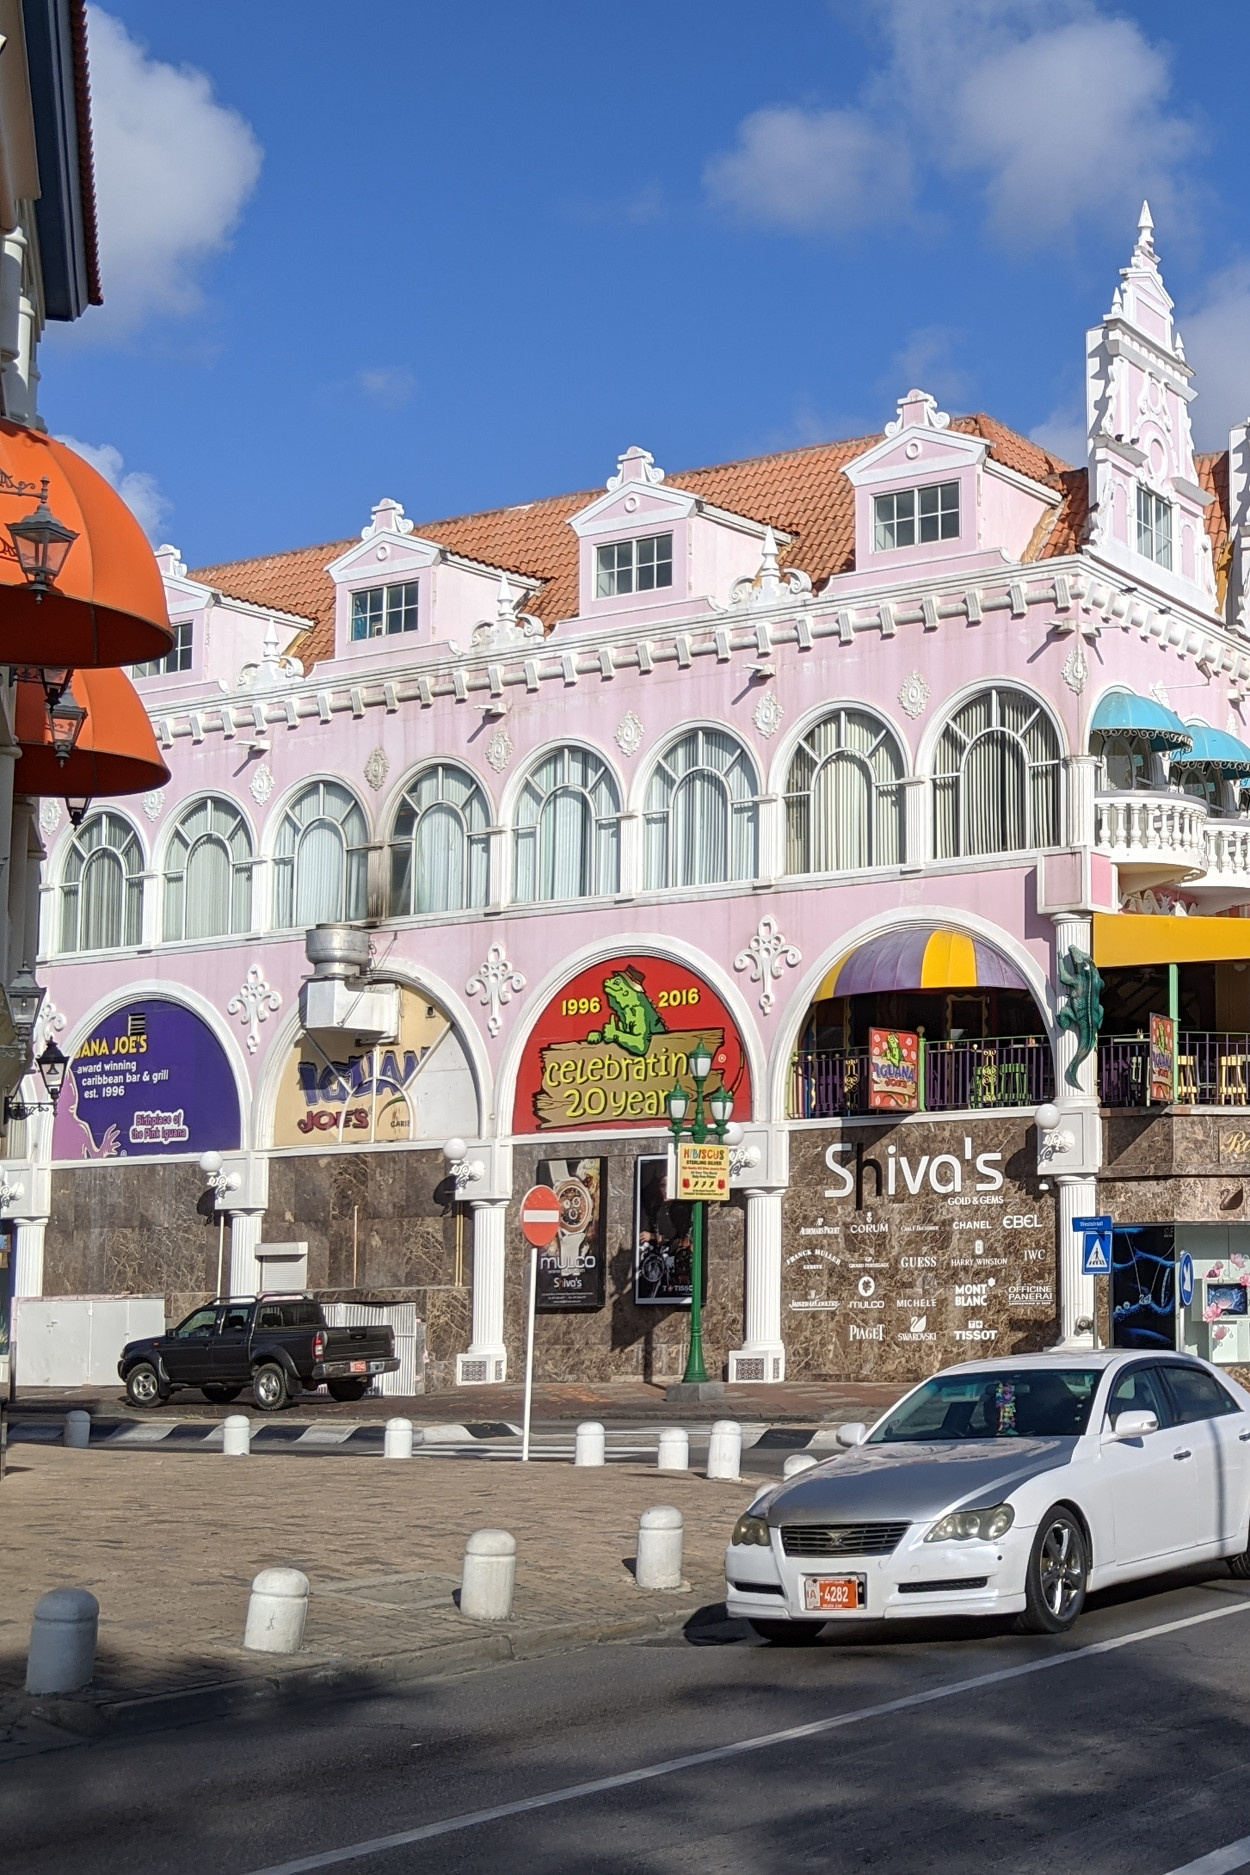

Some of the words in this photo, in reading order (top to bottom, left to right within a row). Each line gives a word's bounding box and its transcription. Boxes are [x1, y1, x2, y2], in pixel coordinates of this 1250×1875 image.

[561, 996, 602, 1016] 1996
[658, 988, 700, 1008] 2016
[112, 1034, 148, 1055] JOE'S
[77, 1061, 102, 1074] award
[104, 1060, 137, 1074] winning
[546, 1047, 688, 1087] celebratin
[874, 1063, 916, 1083] IGUANA
[82, 1075, 124, 1087] caribbean
[126, 1073, 140, 1083] bar
[142, 1071, 150, 1082] &
[152, 1069, 169, 1084] grill
[298, 1046, 431, 1106] IGUAN
[84, 1089, 98, 1099] est.
[102, 1086, 125, 1098] 1996
[564, 1086, 607, 1118] 20
[610, 1088, 669, 1117] year
[136, 1113, 172, 1127] Birthplace
[173, 1112, 182, 1127] of
[131, 1128, 143, 1140] the
[144, 1127, 160, 1139] Pink
[161, 1127, 187, 1142] Iguana
[683, 1148, 725, 1160] HIBISCUS
[825, 1137, 1003, 1211] Shiva's
[948, 1196, 971, 1206] GOLD
[972, 1196, 979, 1205] &
[980, 1196, 1004, 1205] GEMS
[953, 1220, 992, 1230] CHANEL
[1003, 1214, 1042, 1229] EBEL
[850, 1223, 889, 1234] CORUM
[786, 1248, 813, 1266] FRANCK
[814, 1248, 842, 1266] MULLER
[1024, 1249, 1045, 1261] IWC
[901, 1256, 937, 1268] GUESS
[951, 1258, 974, 1267] HARRY
[975, 1257, 1008, 1266] WINSTON
[674, 1284, 693, 1292] TISSO
[955, 1284, 988, 1295] MONT
[1008, 1285, 1052, 1293] OFFICINE
[897, 1298, 937, 1308] MICHELE
[955, 1295, 988, 1306] BLANC
[897, 1332, 937, 1341] SWAROVSKI
[954, 1330, 998, 1341] TISSOT
[824, 1586, 849, 1603] 4282
